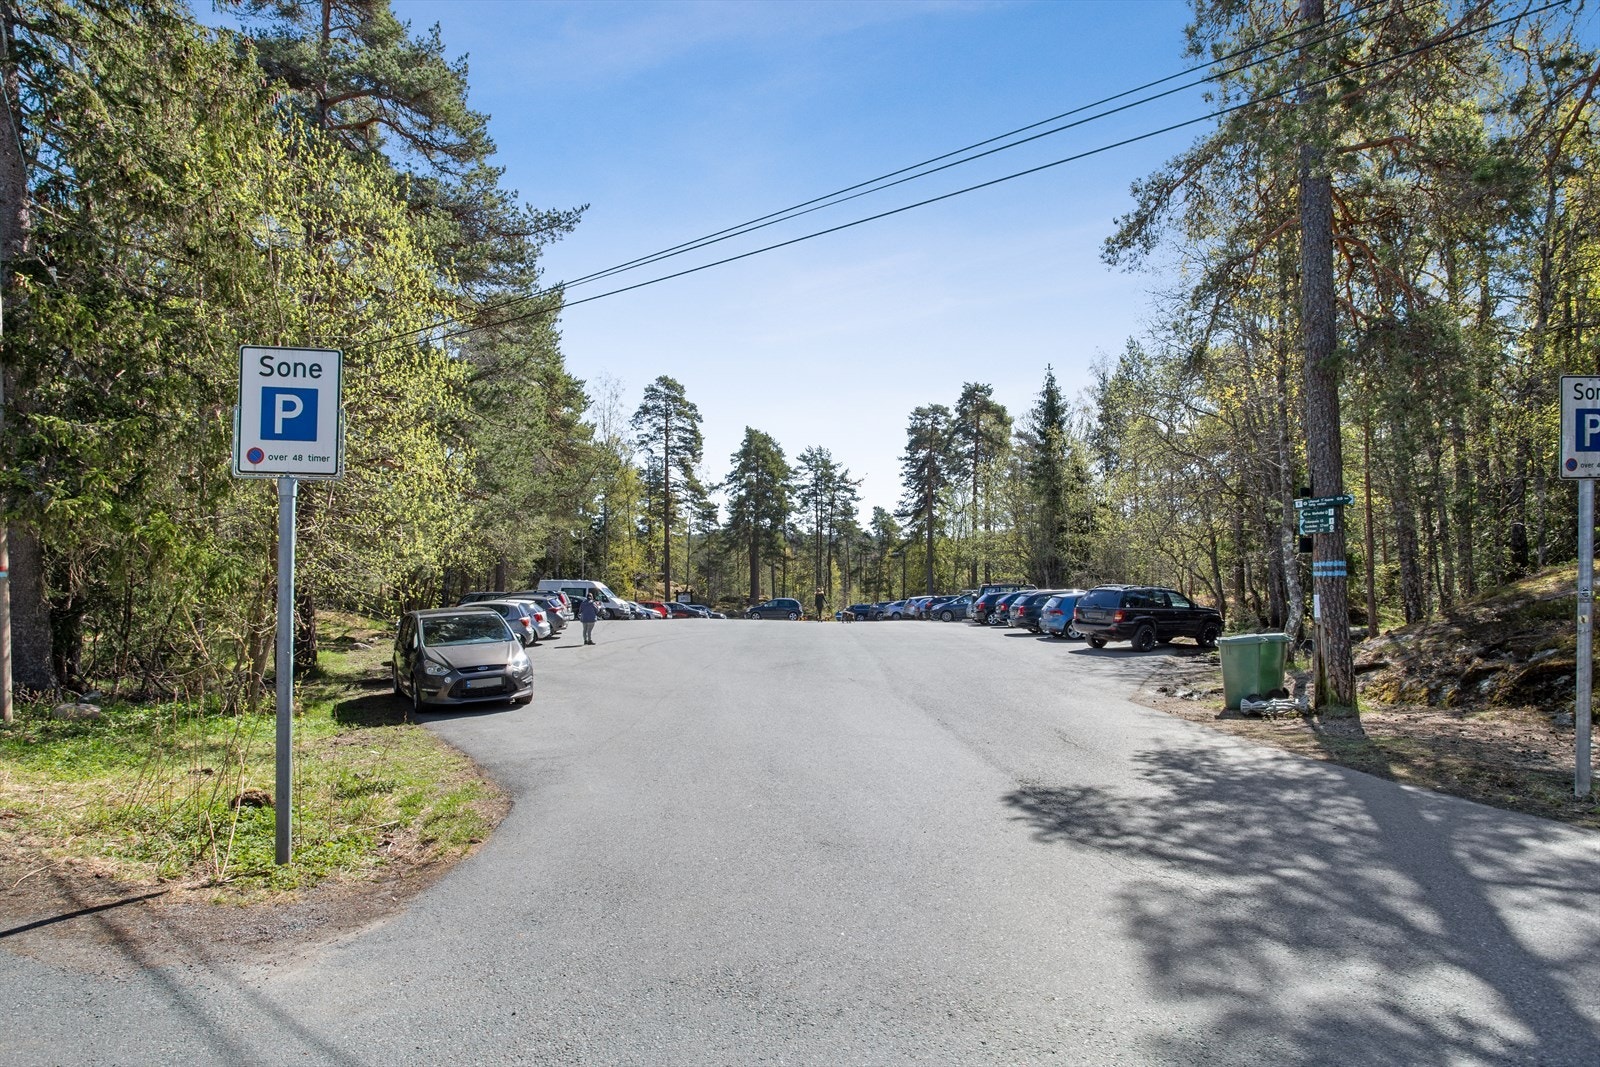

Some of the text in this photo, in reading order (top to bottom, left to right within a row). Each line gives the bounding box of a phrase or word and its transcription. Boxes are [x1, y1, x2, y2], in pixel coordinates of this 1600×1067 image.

[259, 355, 322, 379] Sone
[274, 393, 304, 434] P
[1584, 413, 1600, 447] P
[292, 454, 303, 462] 48
[308, 454, 330, 462] timer
